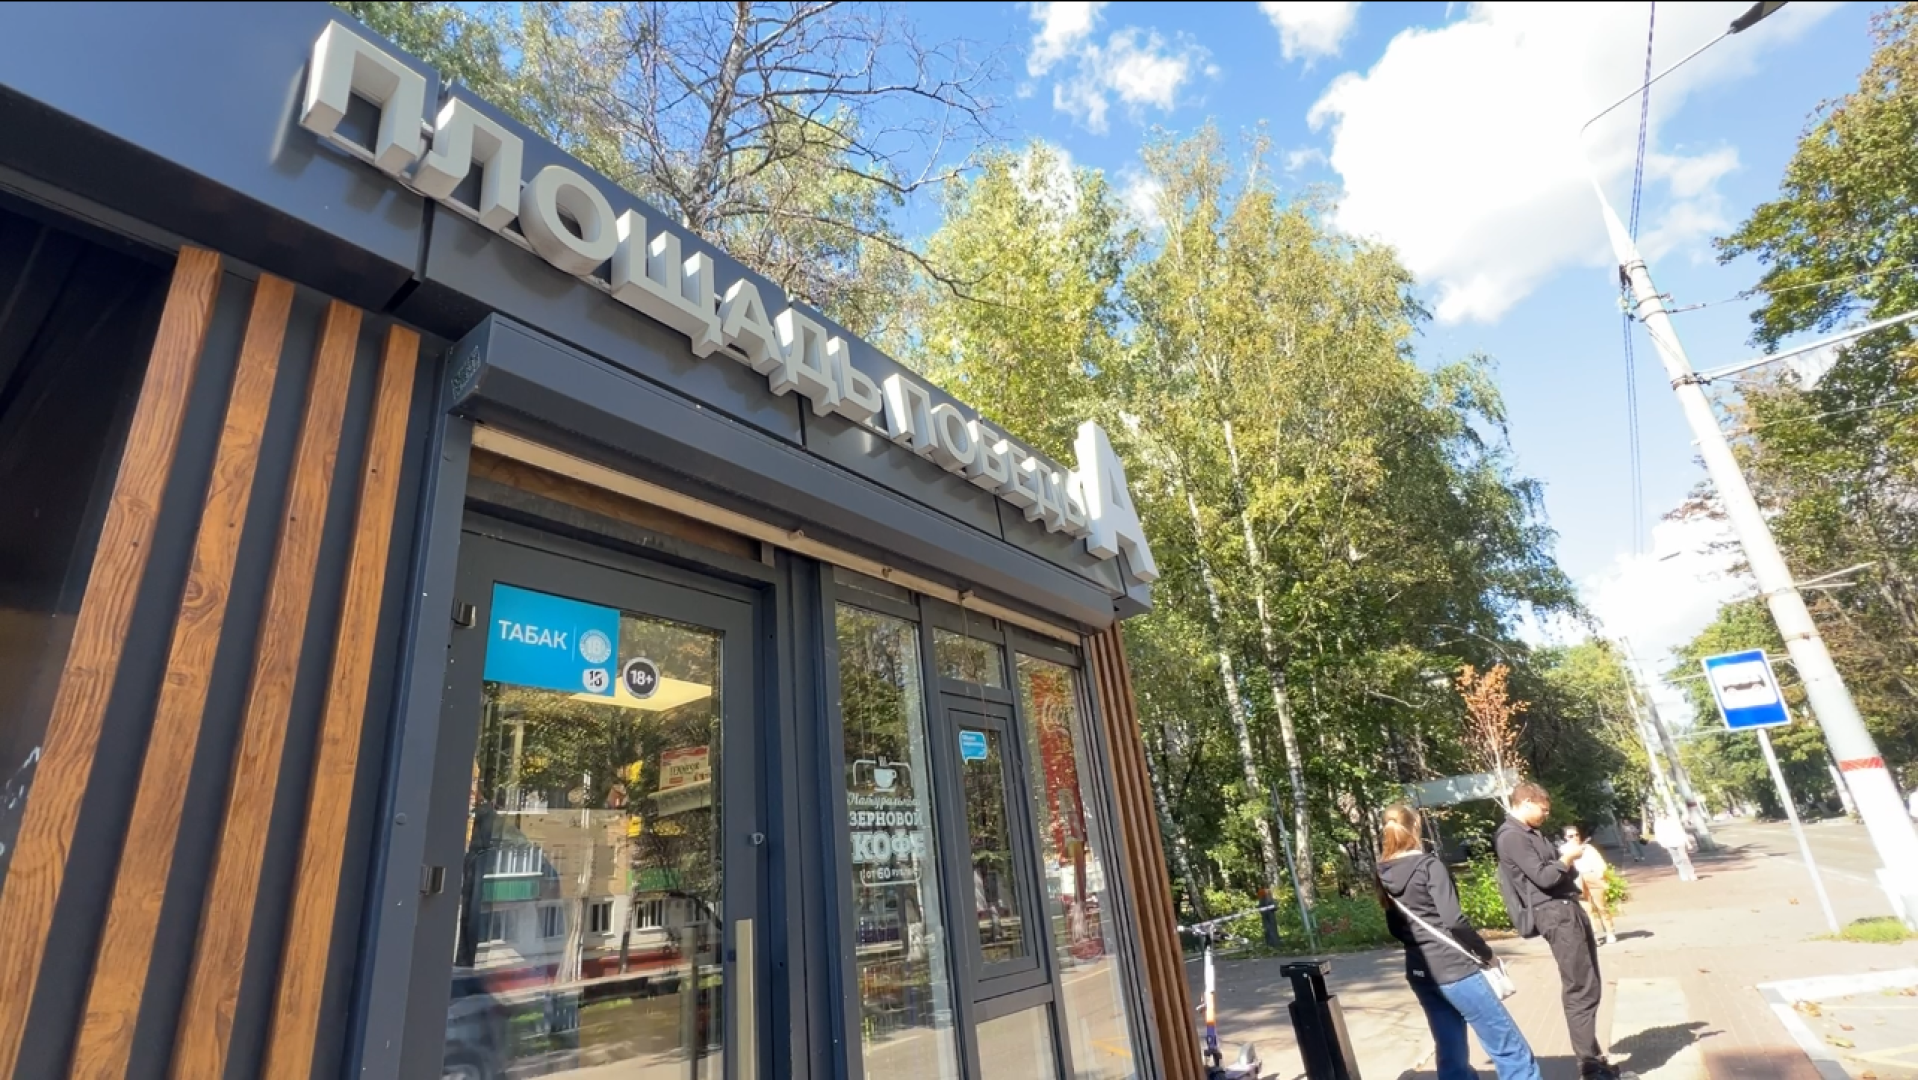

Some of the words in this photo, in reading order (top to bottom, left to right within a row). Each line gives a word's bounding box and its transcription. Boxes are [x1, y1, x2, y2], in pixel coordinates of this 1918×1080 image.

[299, 19, 883, 422] ПЛОЩАДЬ
[882, 373, 1092, 540] ПОБЕДЫ
[498, 619, 568, 651] ТАБАК
[629, 669, 654, 687] 18+
[849, 808, 925, 827] ЗЕРНОВОЙ
[851, 830, 926, 863] КОФЕ
[877, 867, 891, 879] 60
